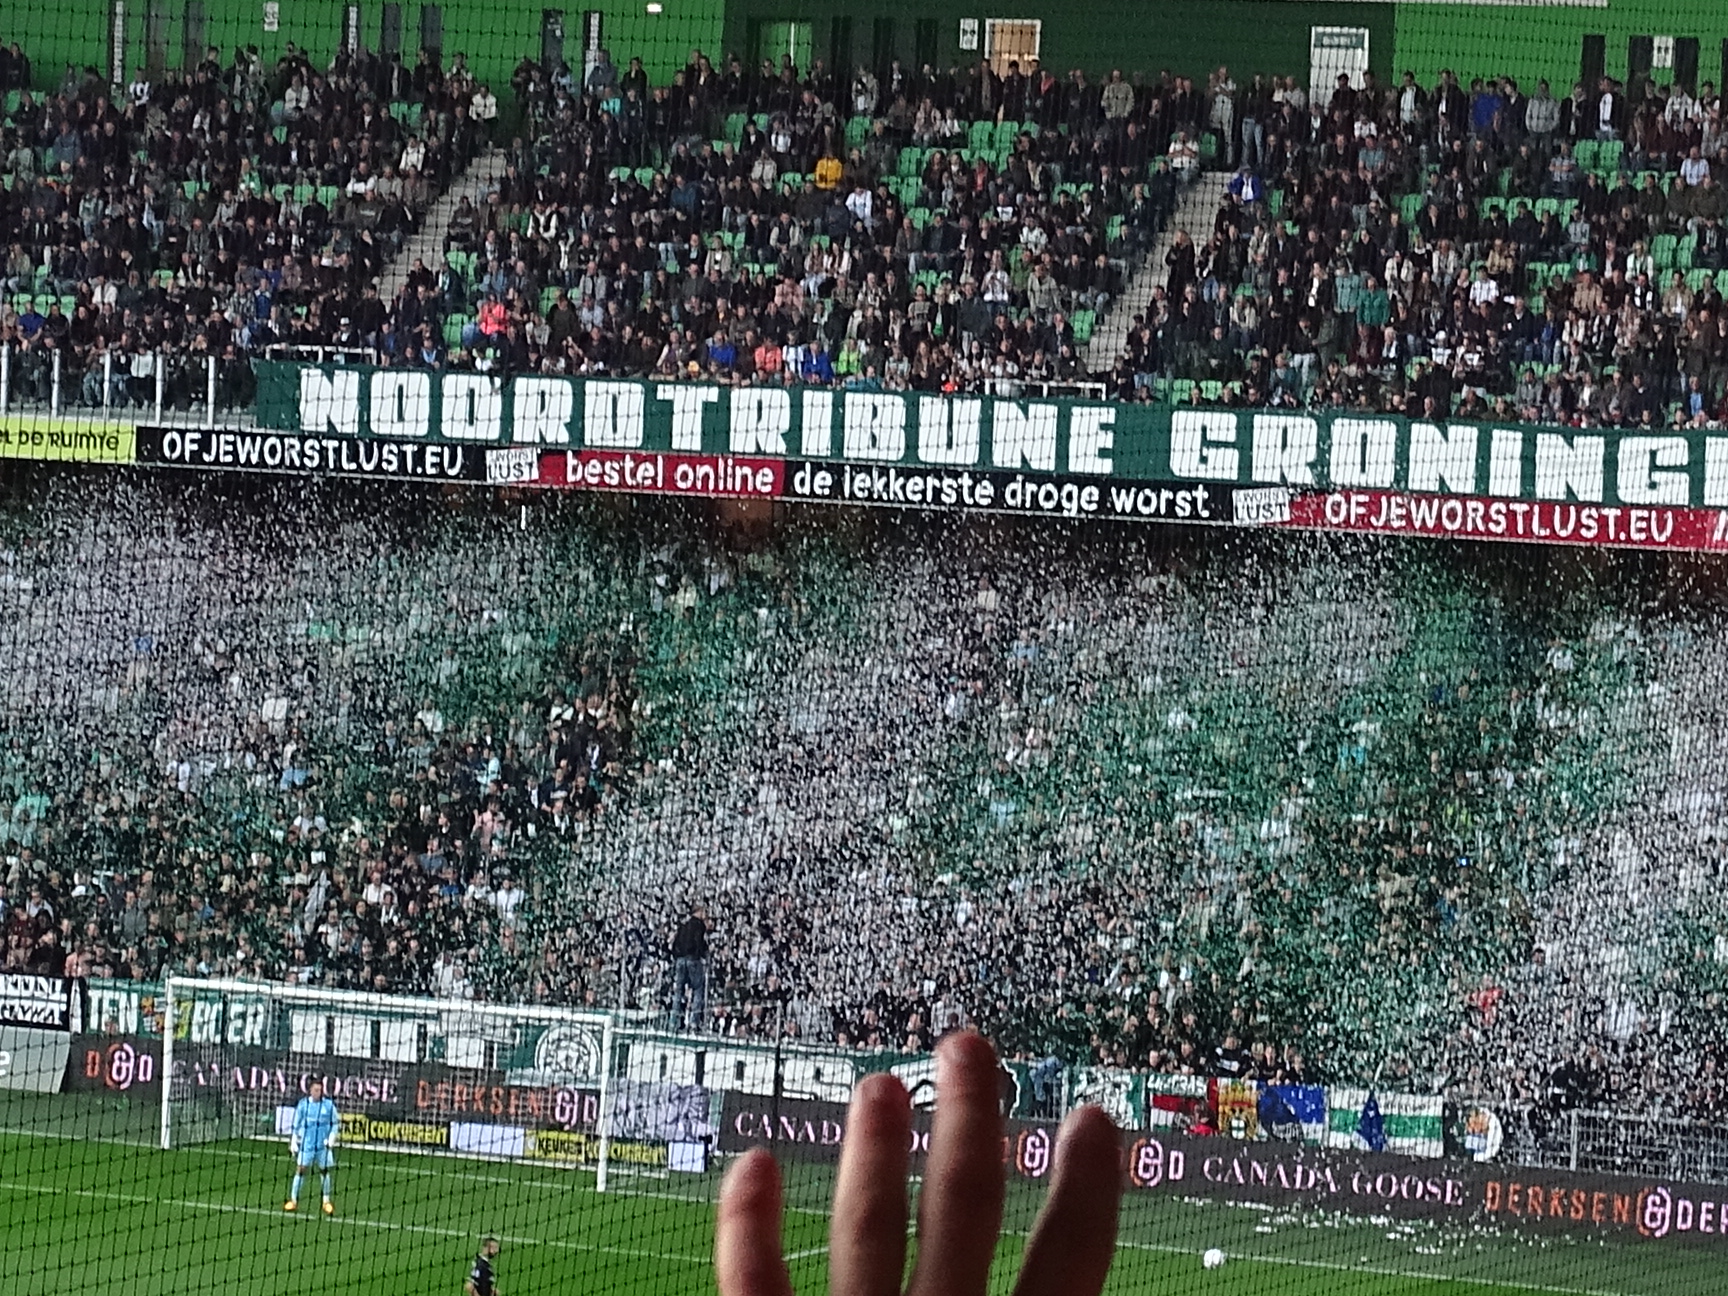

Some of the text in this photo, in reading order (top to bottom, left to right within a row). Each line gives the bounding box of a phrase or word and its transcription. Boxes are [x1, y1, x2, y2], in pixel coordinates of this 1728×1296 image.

[299, 366, 1116, 476] NOORDTRIBUNE
[565, 452, 775, 493] bestel online
[793, 463, 1211, 519] de lekkerste droge worst
[734, 1111, 842, 1146] CANAD
[1203, 1157, 1464, 1206] CANADA GOOSE
